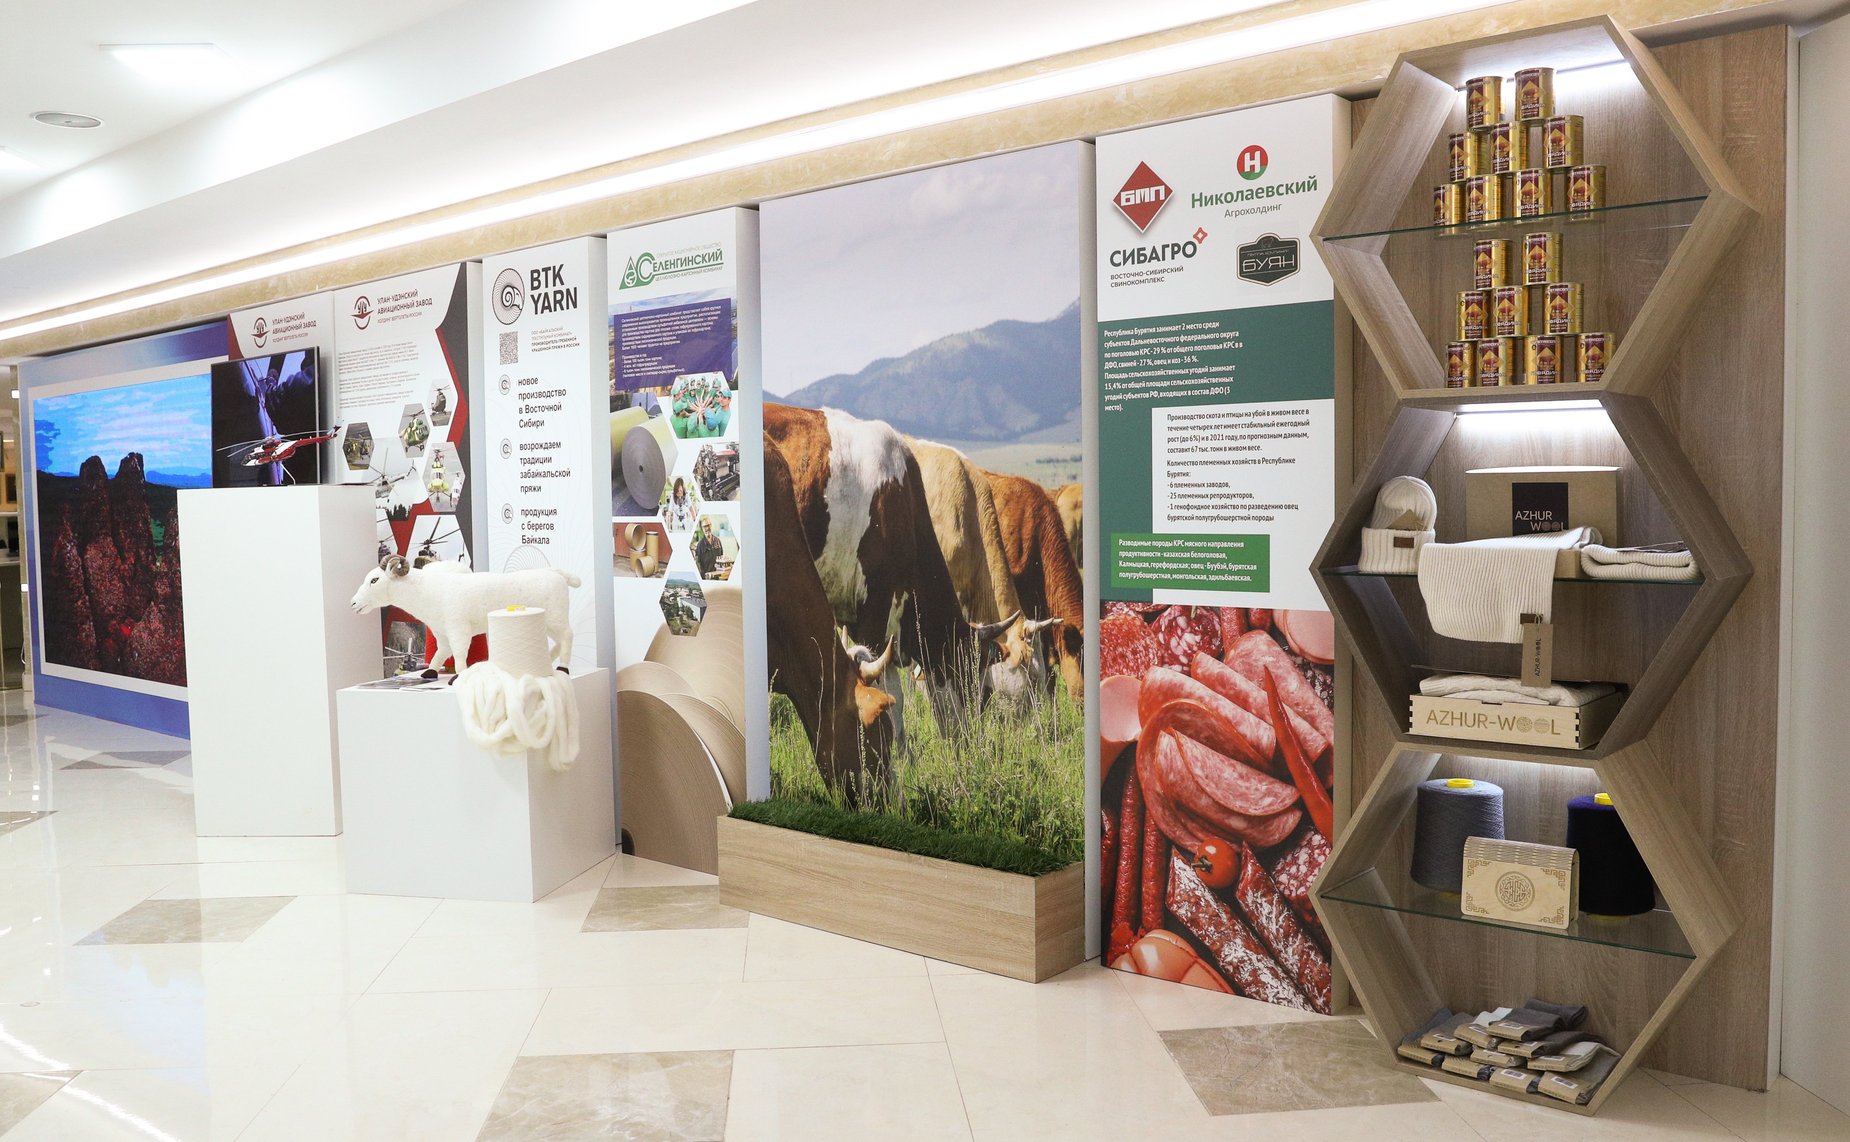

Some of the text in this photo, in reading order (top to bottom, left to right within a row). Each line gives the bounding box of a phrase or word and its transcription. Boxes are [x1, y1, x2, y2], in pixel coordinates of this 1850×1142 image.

[1244, 150, 1261, 173] Н
[1120, 184, 1166, 207] БМП
[1191, 175, 1318, 209] Николаевский
[1224, 204, 1283, 218] Агрохолдинг
[1109, 240, 1198, 268] СИБАГРО
[1242, 254, 1295, 272] БУЯН
[530, 263, 565, 291] BTK
[1110, 265, 1184, 280] ВОСТОЧНО-СИБИРСКИЙ
[1110, 276, 1165, 288] СВИНОКОМПЛЕКС
[415, 297, 433, 308] ЗАВОД
[530, 286, 578, 315] YARN
[1104, 329, 1134, 337] Республика
[1134, 327, 1156, 336] Бурятия
[1202, 321, 1220, 330] среди
[1104, 331, 1239, 349] субъектов Дальневосточного федерального округа
[1140, 347, 1151, 356] КРС
[1153, 347, 1160, 355] 29
[1223, 341, 1235, 349] КРС
[1153, 359, 1167, 367] овец
[1104, 372, 1128, 380] Площадь
[1188, 366, 1208, 375] угодий
[517, 377, 538, 386] новое
[1128, 381, 1145, 389] общей
[1146, 380, 1170, 388] площади
[518, 389, 567, 402] производство
[1104, 393, 1123, 402] угодий
[1123, 391, 1149, 401] субъектов
[1159, 390, 1187, 398] входящих
[1209, 387, 1224, 395] ДФО
[525, 401, 562, 414] Восточной
[1167, 413, 1206, 422] Производство
[1252, 409, 1266, 418] убой
[518, 418, 545, 429] Сибири
[1276, 419, 1310, 427] ежегодный
[1167, 436, 1179, 444] рост
[1180, 435, 1189, 443] (до
[1189, 434, 1201, 443] 6%)
[1247, 433, 1282, 441] прогнозным
[519, 441, 561, 452] возрождаем
[1191, 445, 1198, 453] 67
[520, 456, 552, 466] традиции
[1231, 457, 1257, 465] хозяйств
[1261, 456, 1296, 466] Республике
[520, 468, 571, 479] забайкальской
[1167, 470, 1191, 479] Бурятия:
[520, 485, 542, 494] пряжи
[1173, 503, 1211, 511] генофондное
[1211, 502, 1240, 510] хозяйство
[520, 508, 557, 518] продукция
[1167, 514, 1195, 522] бурятской
[1195, 513, 1251, 522] полугрубошерстной
[1515, 510, 1552, 520] AZHUR
[521, 520, 554, 532] с берегов
[1530, 521, 1564, 531] WOOL
[521, 535, 550, 545] Байкала
[1119, 539, 1151, 547] Разводимые
[1173, 539, 1185, 547] КРС
[1207, 541, 1244, 549] направления
[1190, 551, 1228, 559] белоголовая,
[1119, 560, 1151, 568] Калмыцкая,
[1228, 563, 1257, 572] бурятская
[1425, 709, 1561, 736] AZHUR-WOOL
